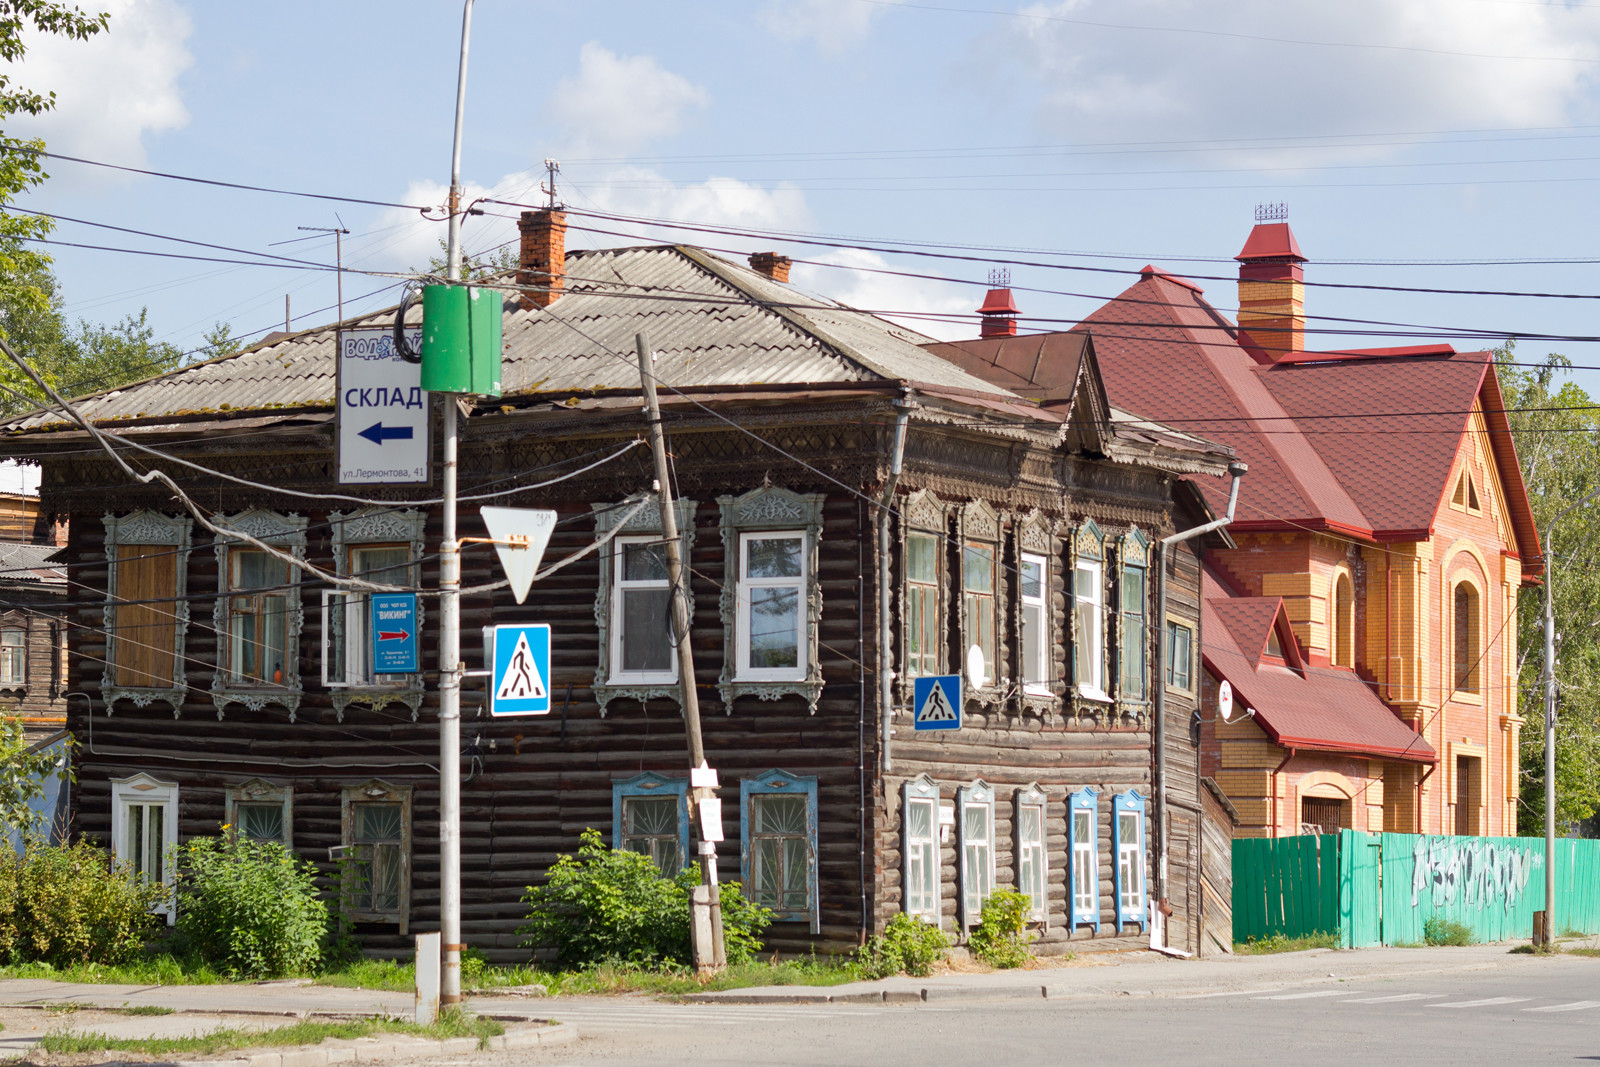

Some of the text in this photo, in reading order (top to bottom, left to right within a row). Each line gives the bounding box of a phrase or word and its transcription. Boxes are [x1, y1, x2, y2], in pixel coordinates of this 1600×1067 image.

[345, 387, 423, 410] СКЛАД
[343, 467, 424, 480] ул.Лермонтова, 41
